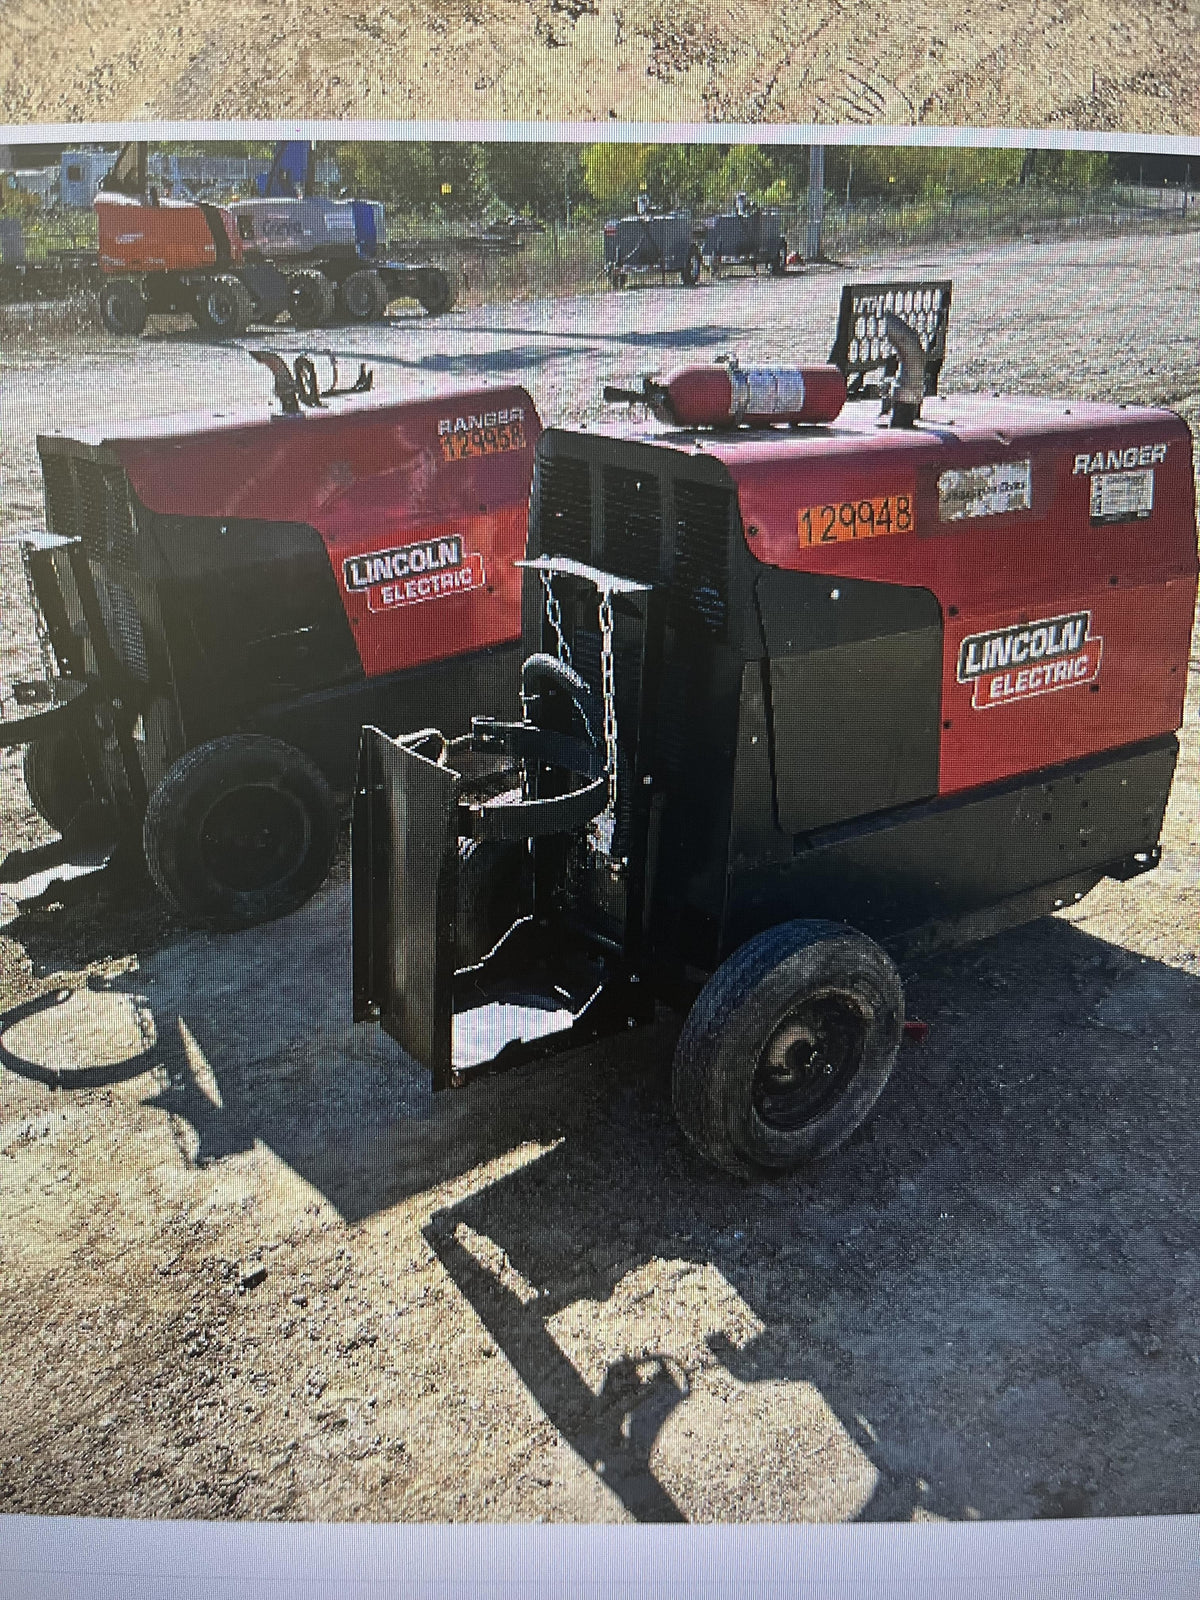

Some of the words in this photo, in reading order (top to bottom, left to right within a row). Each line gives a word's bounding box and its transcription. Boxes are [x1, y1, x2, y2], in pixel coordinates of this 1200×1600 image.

[438, 407, 525, 436] RANGER
[1072, 443, 1167, 474] RANGER
[801, 496, 912, 544] 129948
[350, 542, 459, 586] LINCOLN
[381, 566, 473, 605] ELECTRIC
[965, 618, 1084, 675] LINCOLN
[989, 654, 1089, 699] ELECTRIC
